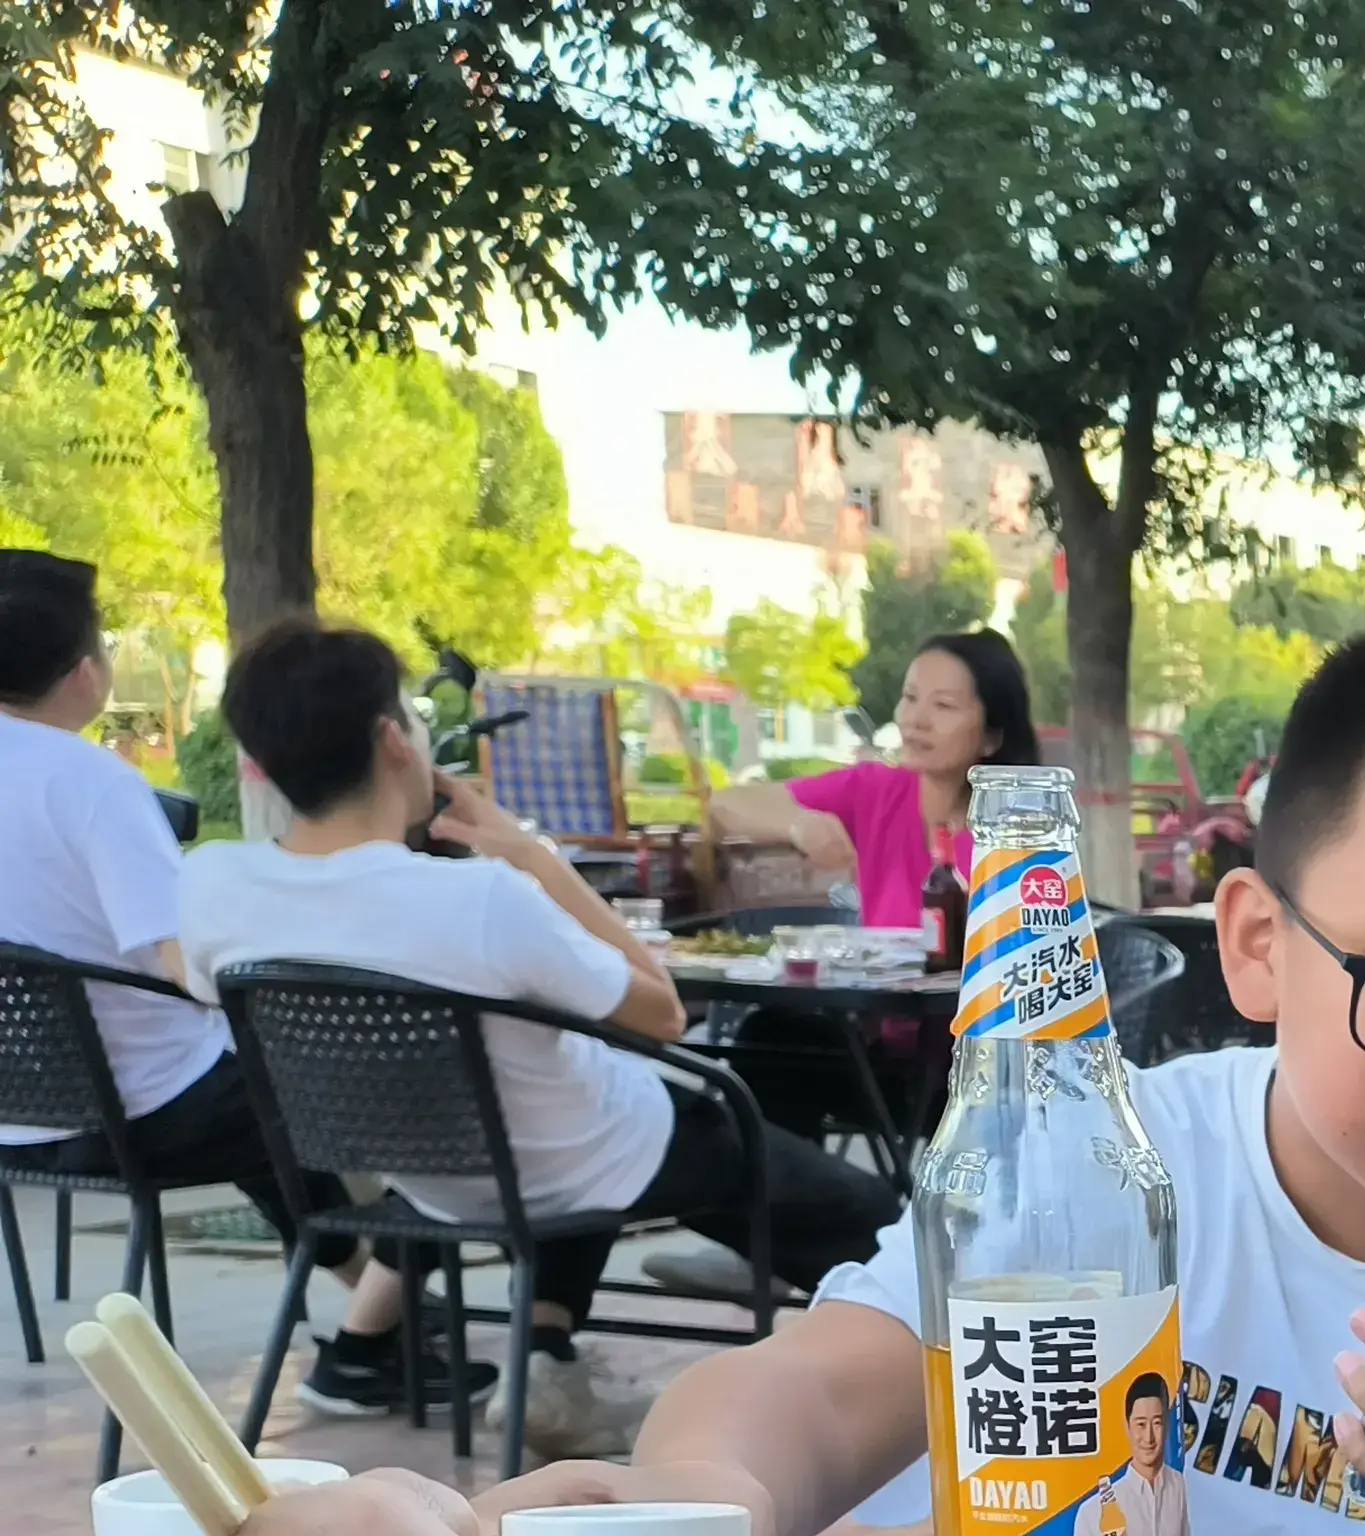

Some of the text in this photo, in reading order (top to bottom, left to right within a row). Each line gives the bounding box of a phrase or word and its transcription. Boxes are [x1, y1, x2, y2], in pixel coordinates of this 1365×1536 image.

[1021, 908, 1070, 927] DAYAO
[1022, 877, 1063, 899] 大窑
[1003, 935, 1081, 997] 大汽水
[1018, 962, 1093, 1025] 喝大窑
[963, 1316, 1097, 1383] 大窑
[966, 1387, 1098, 1456] 橙诺
[969, 1477, 1048, 1510] DAYAO
